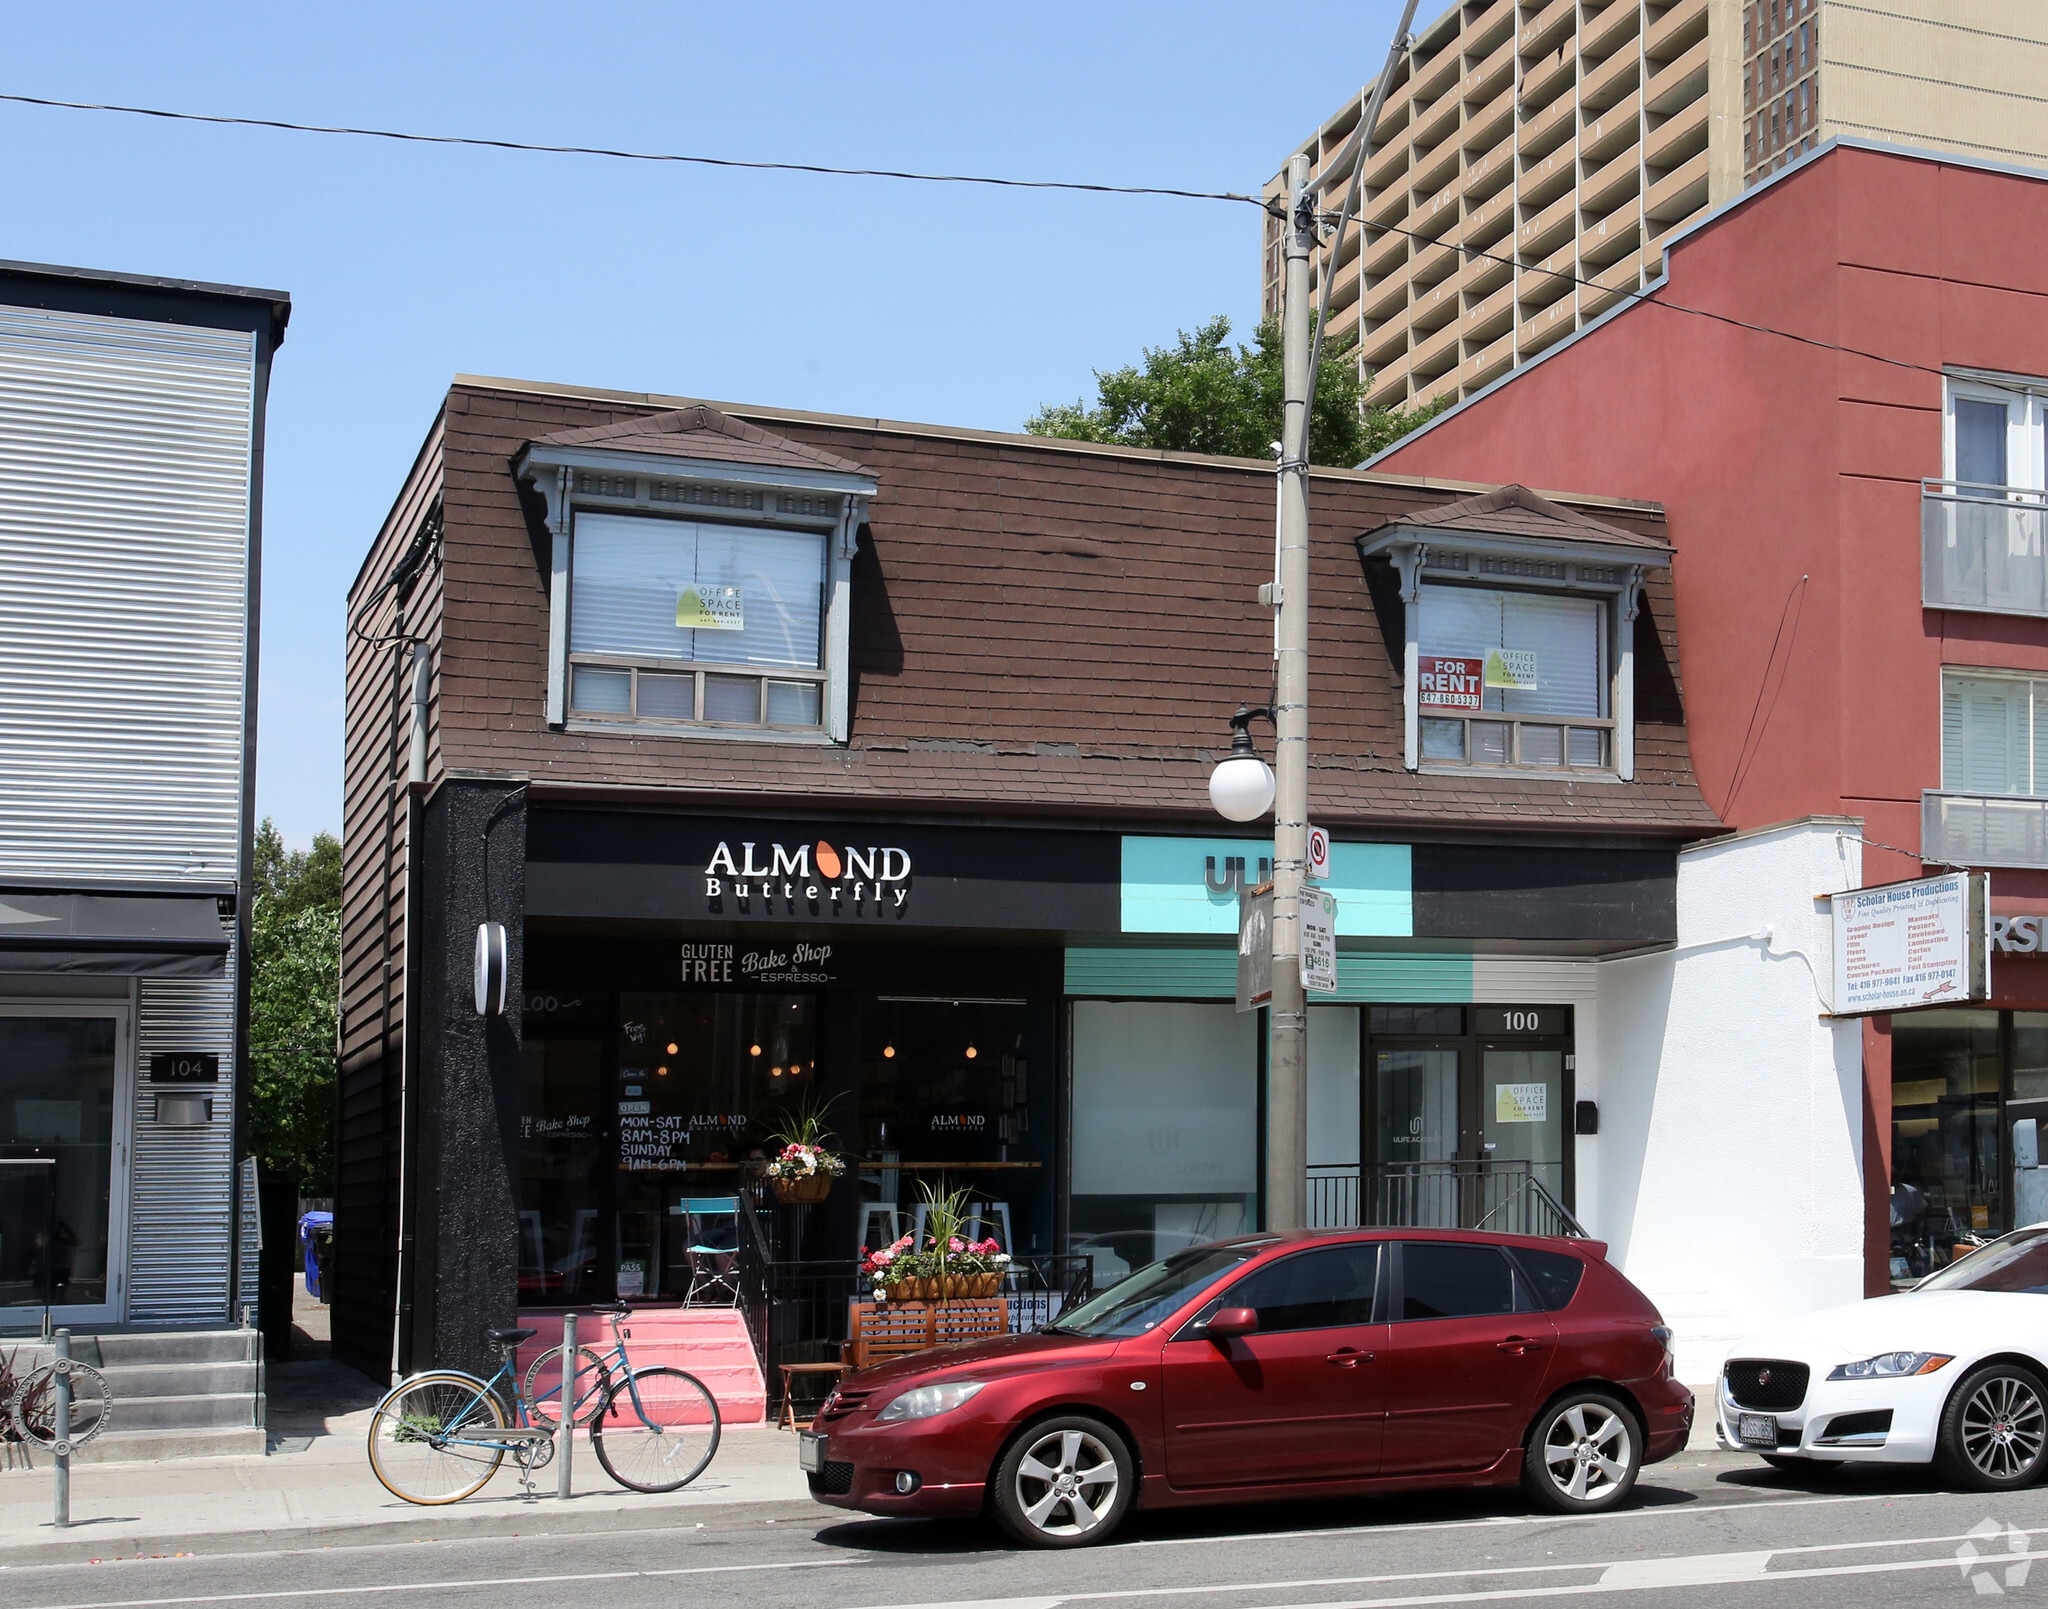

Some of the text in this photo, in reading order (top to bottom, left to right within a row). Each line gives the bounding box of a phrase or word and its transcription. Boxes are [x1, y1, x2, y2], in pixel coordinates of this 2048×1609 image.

[700, 599, 741, 610] SPACE
[1503, 652, 1535, 662] OFFICE
[1435, 660, 1466, 674] FOR
[1503, 662, 1535, 672] SPACE
[1421, 672, 1479, 693] RENT
[704, 840, 912, 881] ALMOND
[1205, 855, 1275, 894] ULI
[705, 877, 907, 907] Butterfly
[1857, 881, 1959, 908] Scholar House Productions
[1857, 909, 1870, 918] Fine
[1871, 905, 1892, 917] Quality
[1893, 901, 1917, 912] Printing
[1925, 895, 1959, 908] Duplicating
[1908, 913, 1940, 923] Manuals
[1847, 920, 1895, 933] Graphic Design
[1908, 922, 1936, 931] Posters
[1847, 932, 1868, 941] Layout
[1908, 928, 1945, 939] Envelopes
[1990, 915, 2048, 952] RS
[1908, 936, 1949, 947] Laminating
[681, 943, 733, 959] GLUTEN
[1847, 949, 1866, 957] Flyers
[741, 943, 833, 973] Bake Shop
[1847, 956, 1866, 964] Forms
[1908, 955, 1922, 963] Coil
[681, 960, 733, 982] FREE
[791, 965, 798, 973] &
[1847, 962, 1880, 971] Brochures
[1908, 959, 1958, 971] Foil Stamping
[760, 972, 828, 983] ESPRESSO
[1847, 967, 1902, 979] Course Packages
[1860, 980, 1871, 989] 416
[1902, 975, 1914, 984] Fax
[1914, 973, 1926, 982] 416
[1503, 1011, 1540, 1031] 100
[171, 1059, 203, 1077] 104
[1513, 1086, 1544, 1094] OFFICE
[1513, 1095, 1544, 1105] SPACE
[620, 1104, 647, 1112] OPEN
[536, 1118, 564, 1132] Bake
[567, 1114, 590, 1128] Shop
[620, 1116, 682, 1129] MON-SAT
[621, 1143, 672, 1157] SUNDAY
[620, 1263, 641, 1271] PASS
